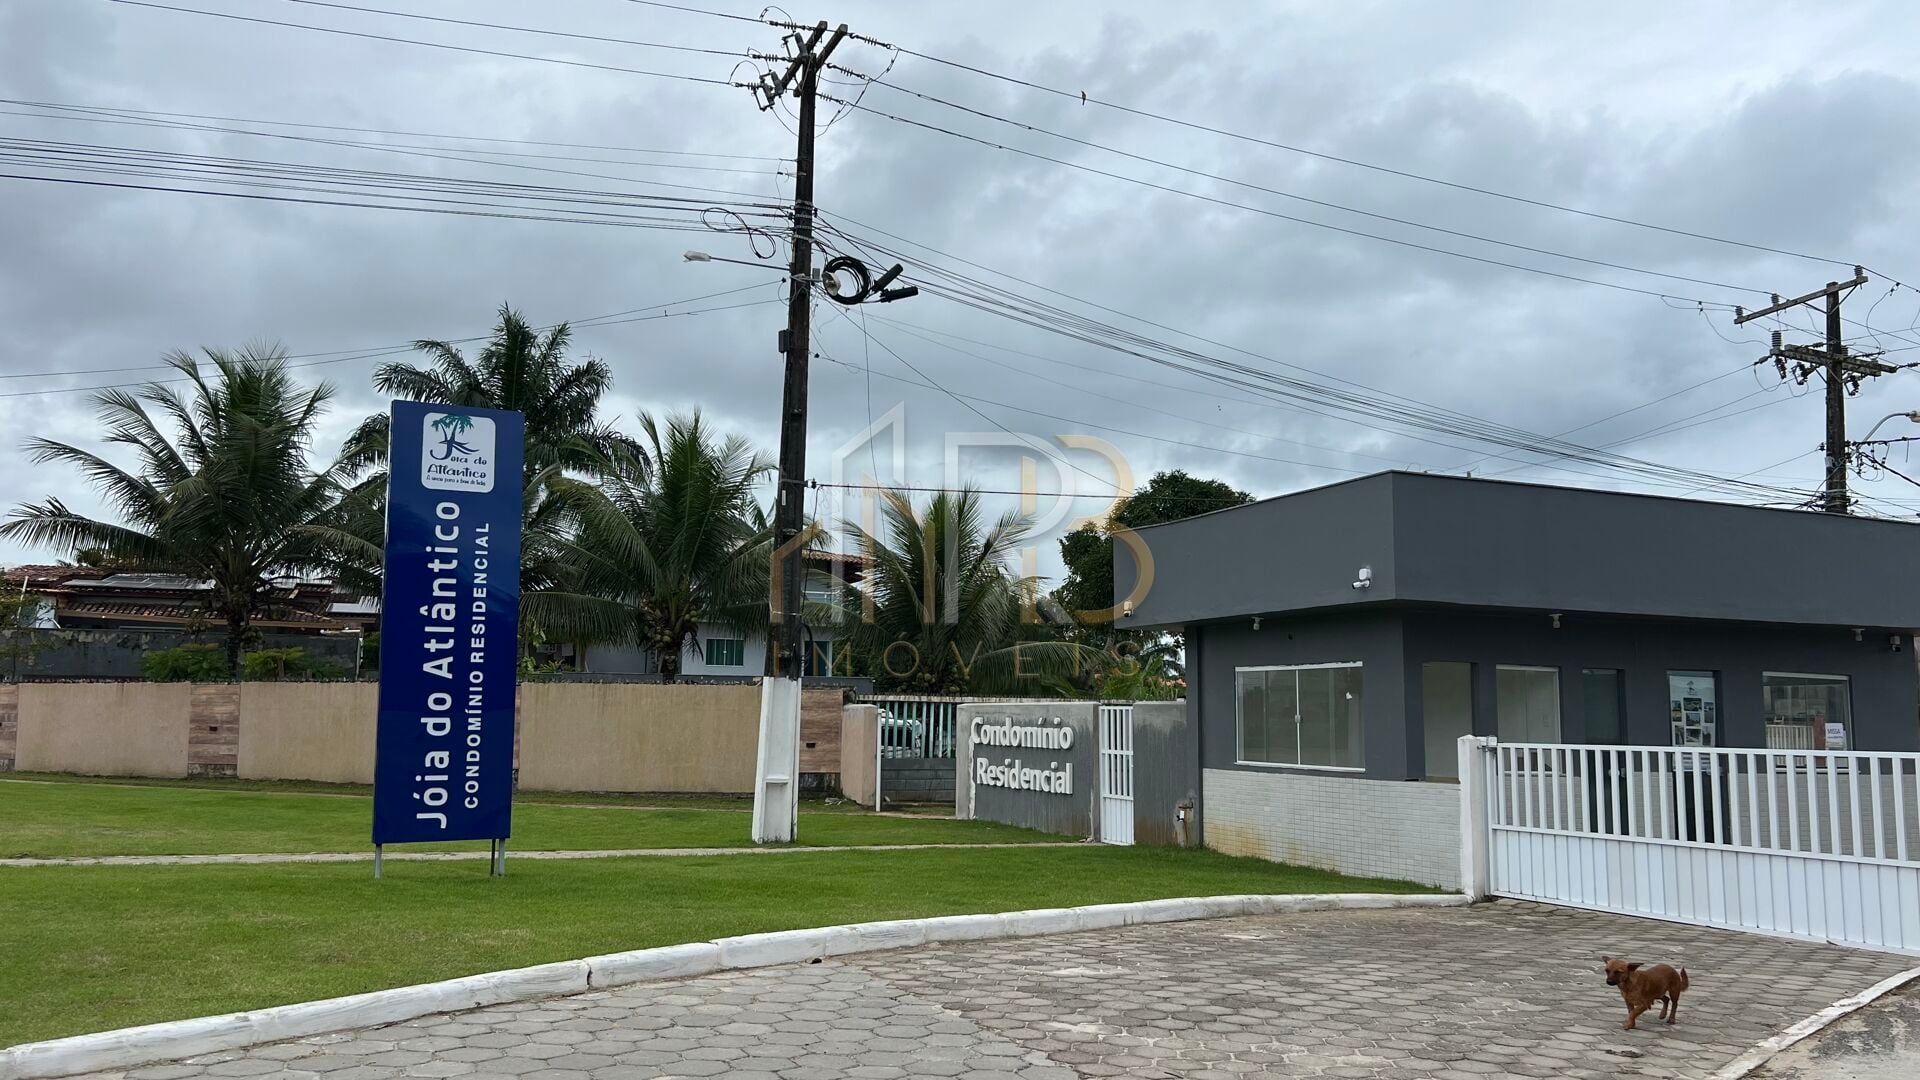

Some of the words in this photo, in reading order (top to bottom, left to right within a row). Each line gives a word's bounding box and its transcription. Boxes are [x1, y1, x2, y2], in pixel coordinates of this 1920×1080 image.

[427, 463, 487, 479] Atlantico
[474, 457, 487, 465] do
[419, 501, 461, 679] Atlântico
[470, 523, 489, 662] RESIDENCIAL
[421, 692, 452, 737] do
[971, 716, 1074, 750] Condomínio
[465, 671, 484, 809] CONDOMÍNIO
[413, 751, 450, 829] Jóia
[976, 758, 1074, 795] Residencial
